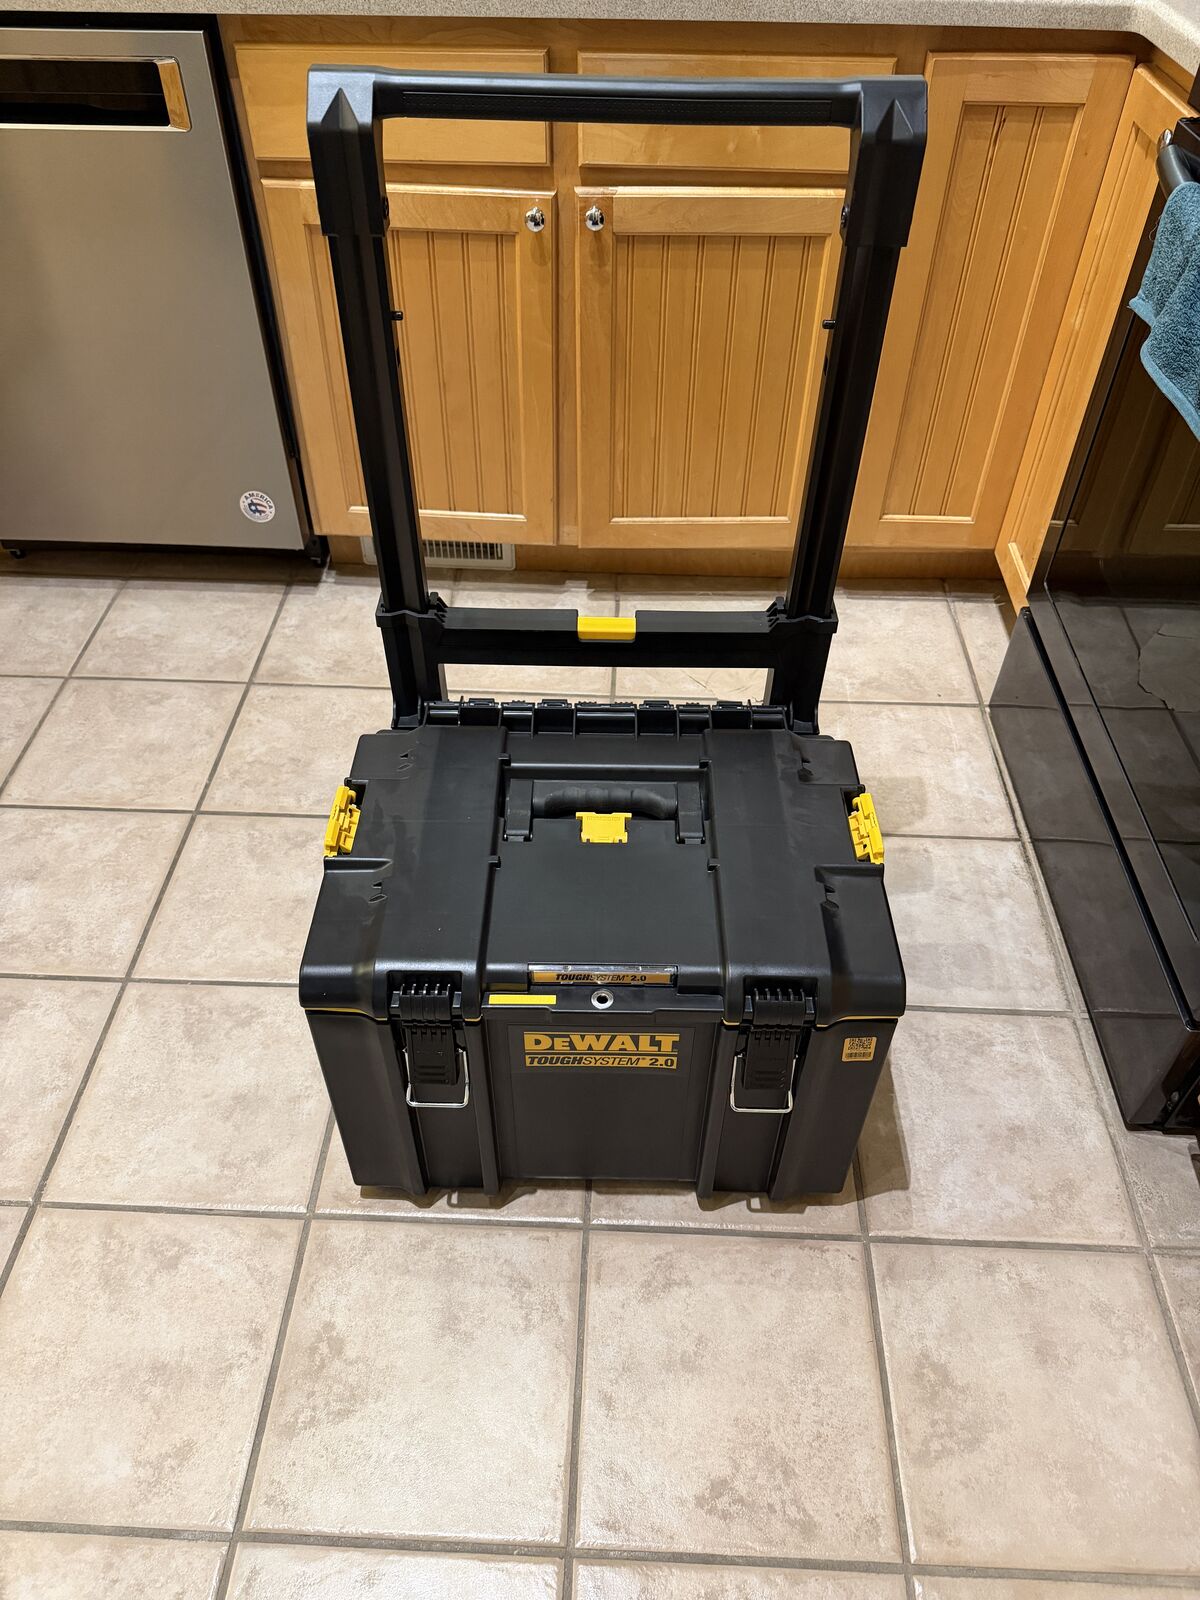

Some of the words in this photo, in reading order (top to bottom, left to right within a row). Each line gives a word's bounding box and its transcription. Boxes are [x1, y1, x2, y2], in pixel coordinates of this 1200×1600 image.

[244, 492, 273, 509] AMERICA
[630, 974, 647, 982] 2.0
[648, 1057, 675, 1067] 2.0
